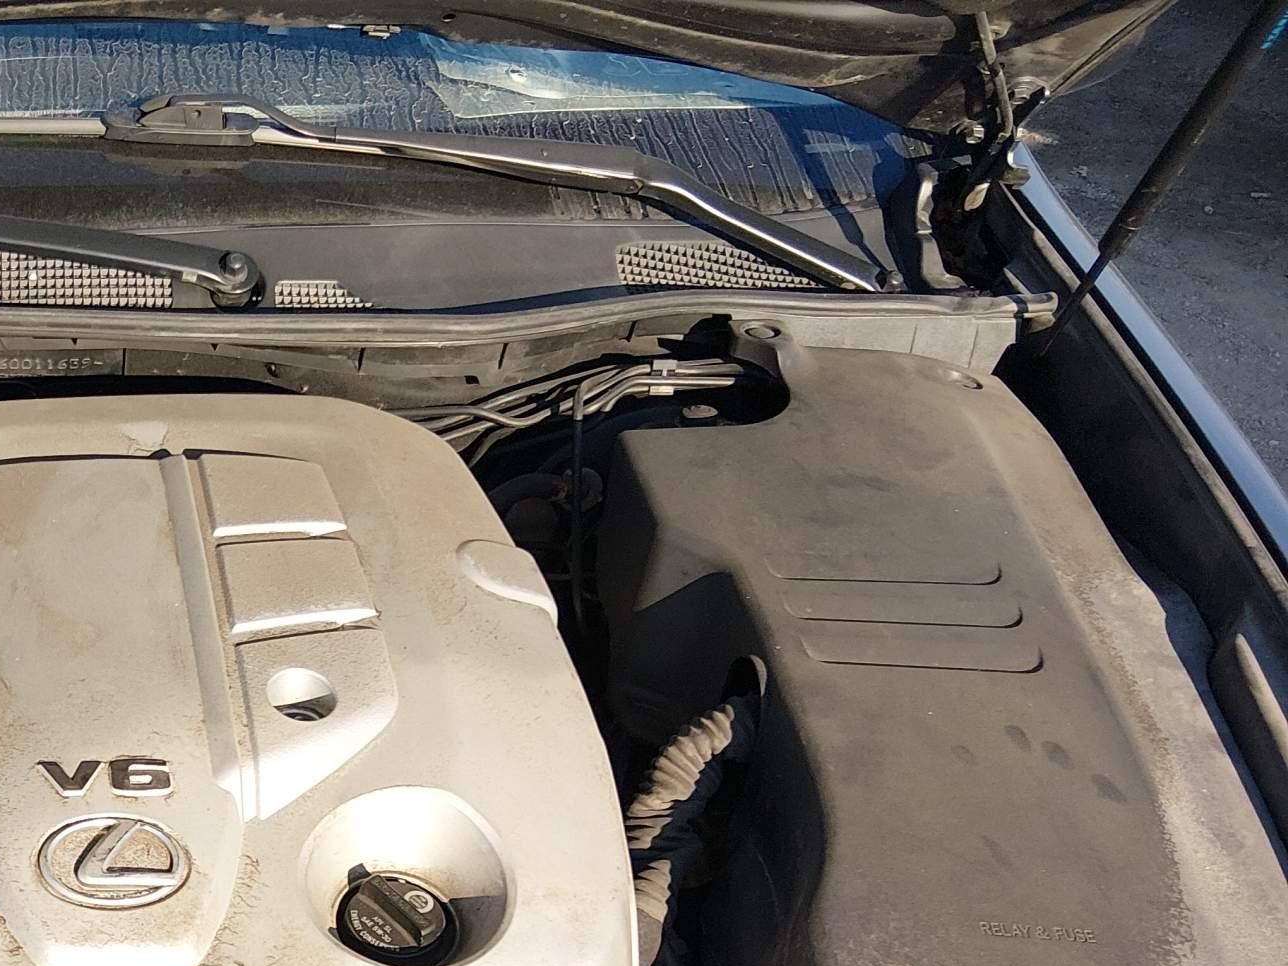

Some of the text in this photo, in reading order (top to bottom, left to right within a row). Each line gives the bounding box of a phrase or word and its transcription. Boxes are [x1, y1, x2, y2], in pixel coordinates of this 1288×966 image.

[37, 757, 173, 798] V6
[360, 916, 374, 927] SAE
[979, 921, 1097, 944] RELAY & FUSE
